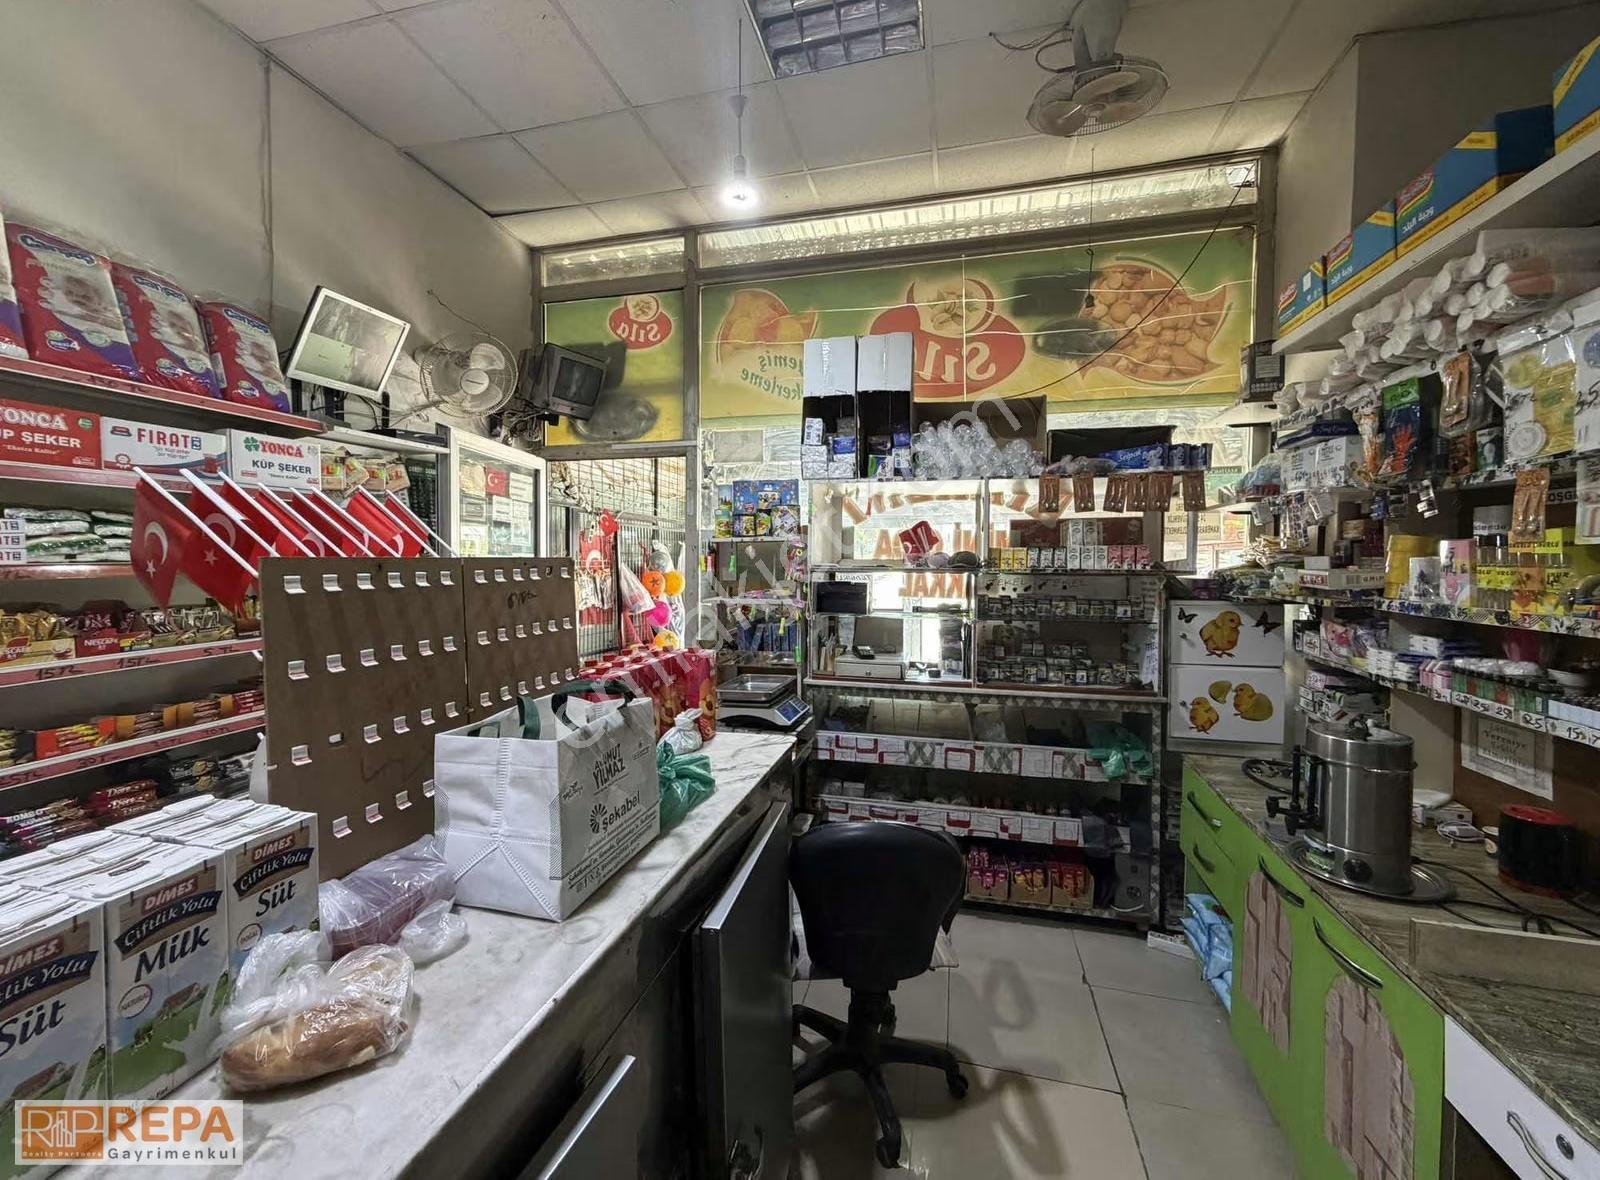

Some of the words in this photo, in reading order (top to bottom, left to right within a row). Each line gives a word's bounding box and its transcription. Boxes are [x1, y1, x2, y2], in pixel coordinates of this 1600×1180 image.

[0, 405, 68, 431] ONCA
[21, 431, 81, 449] ŞEKER
[259, 440, 304, 459] YONCA
[252, 459, 275, 471] KÜP
[278, 463, 312, 476] ŞEKER
[592, 758, 626, 790] YILMAZ
[254, 836, 293, 861] DİMES
[240, 859, 280, 891] Çiftlik
[282, 851, 308, 867] Yolu
[145, 878, 194, 910] DİMES
[256, 880, 296, 918] Süt
[124, 907, 178, 948] Çiftlik
[181, 896, 214, 914] Yolu
[134, 925, 210, 983] Milk
[0, 976, 34, 999] lik
[42, 959, 88, 982] Yolu
[0, 1000, 66, 1058] Süt
